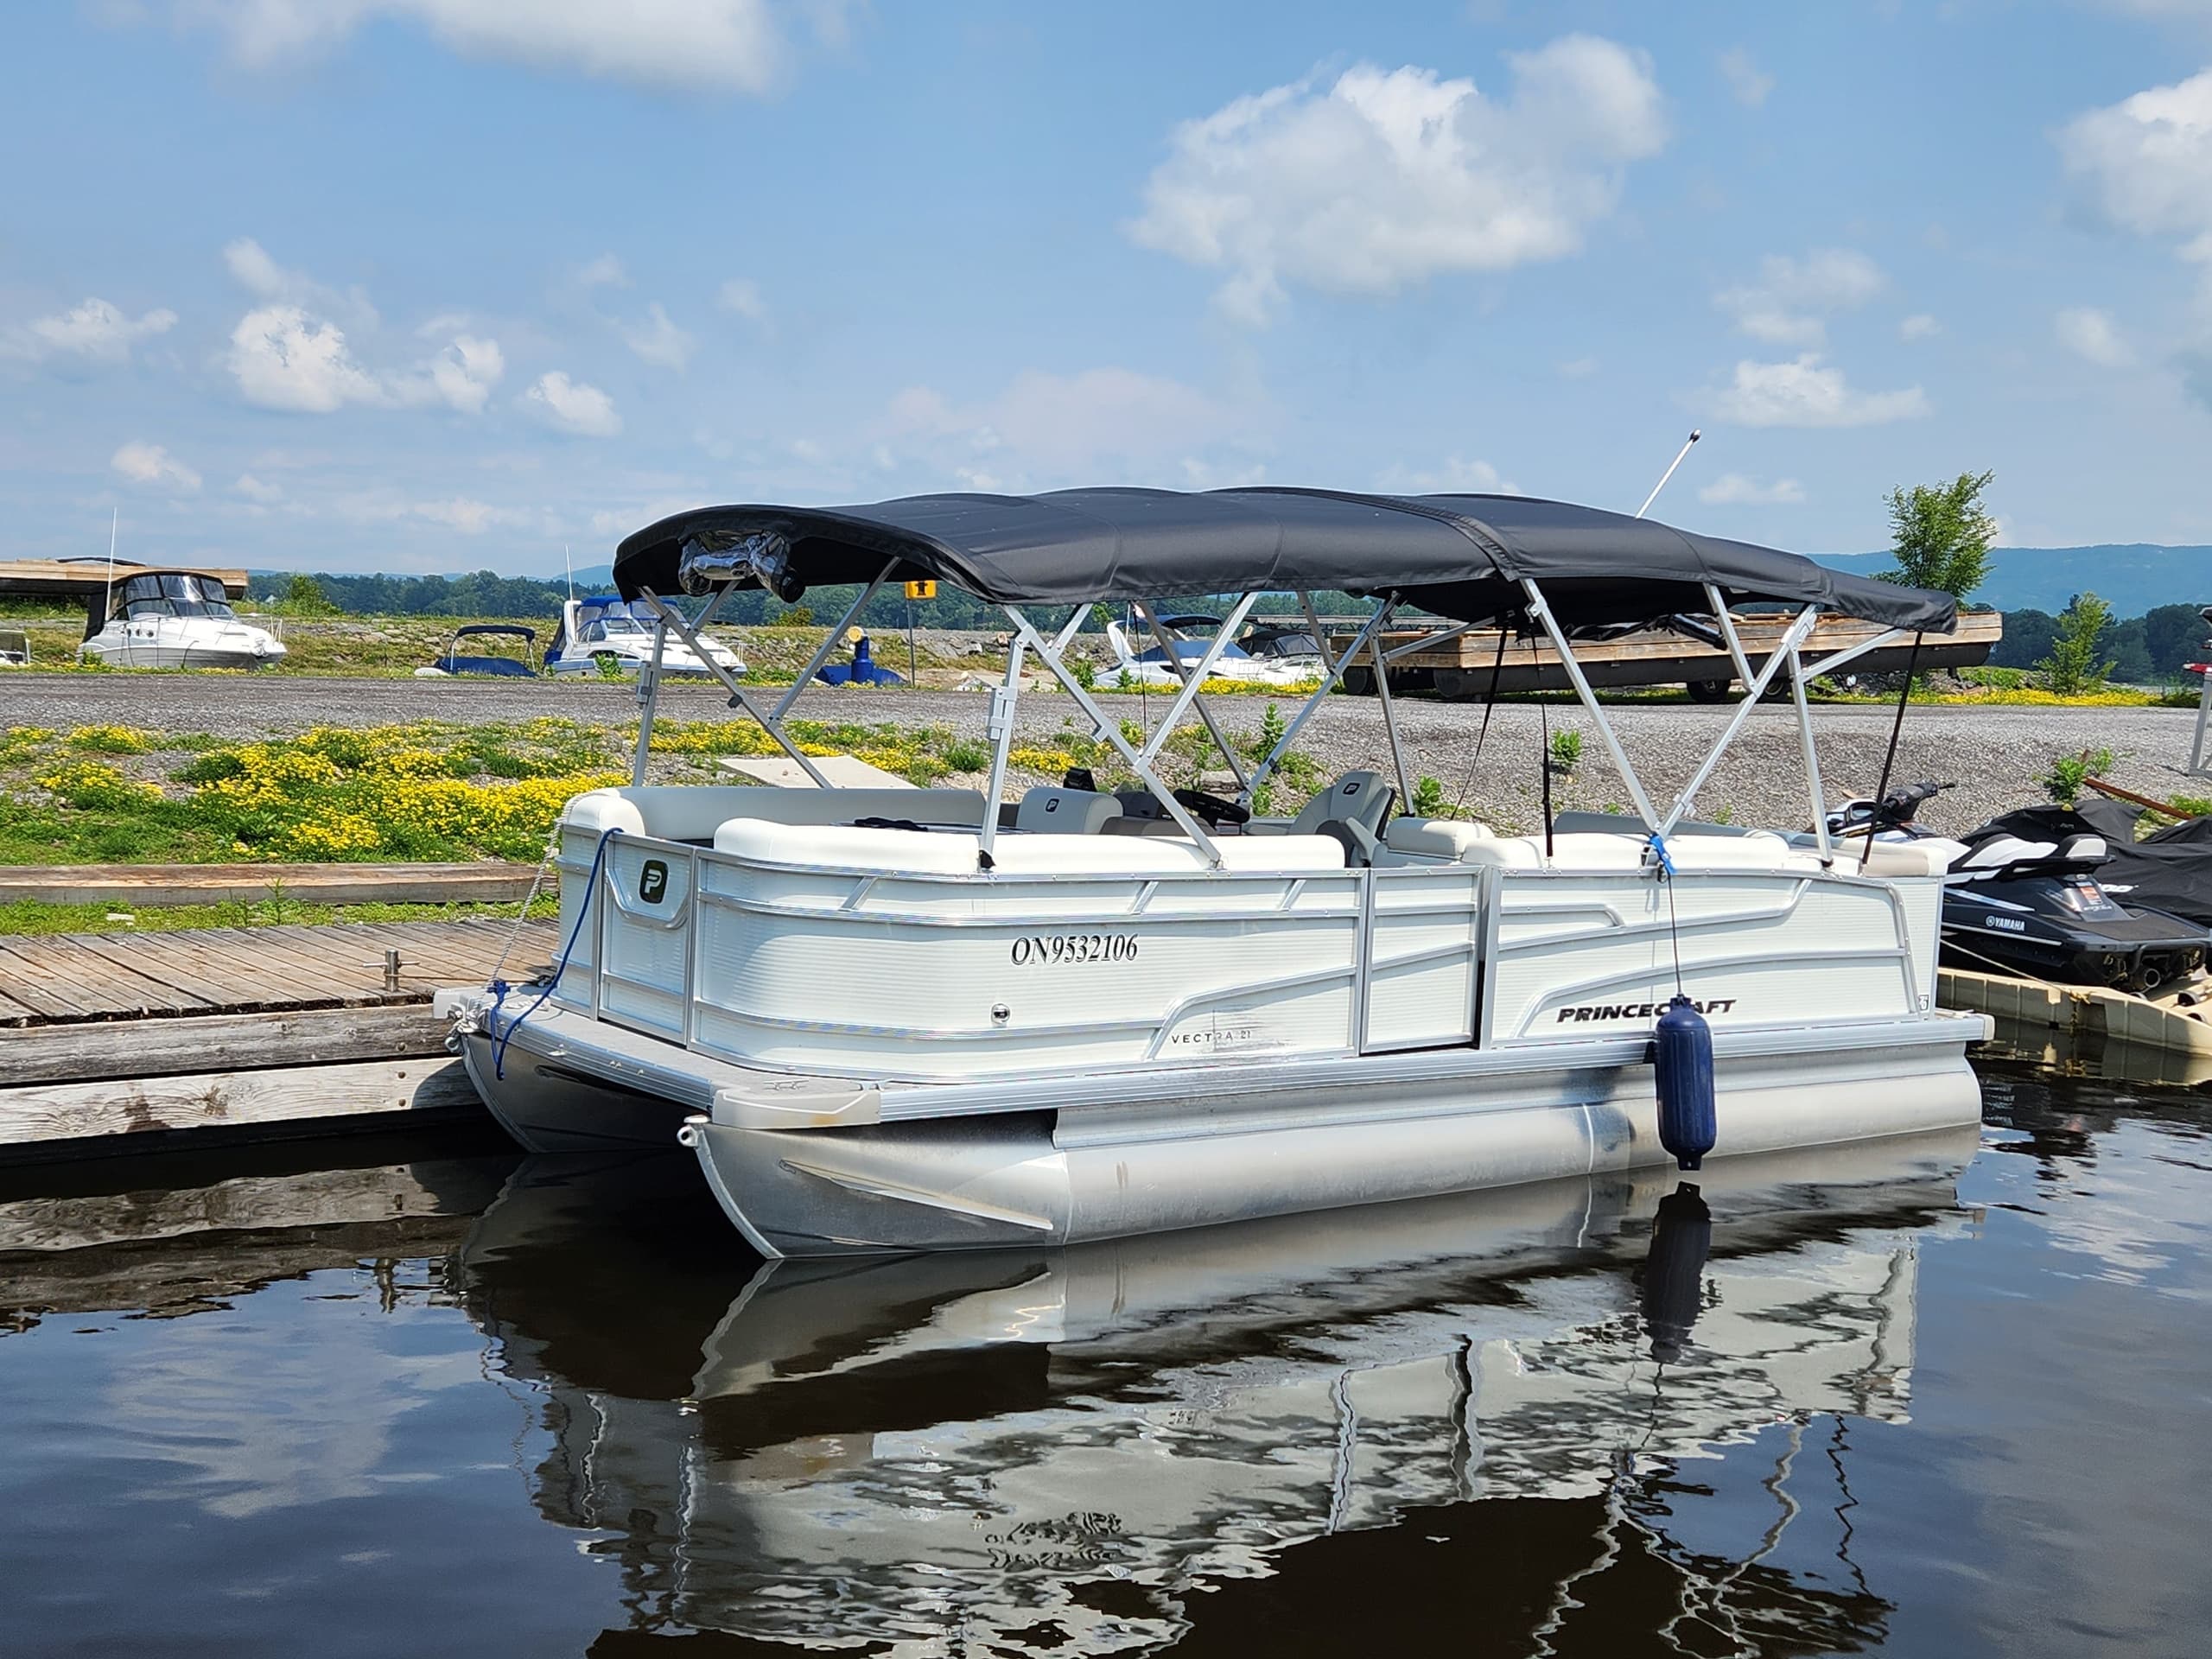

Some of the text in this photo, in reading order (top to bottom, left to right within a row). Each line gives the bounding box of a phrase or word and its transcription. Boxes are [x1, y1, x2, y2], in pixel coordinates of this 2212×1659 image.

[1995, 917, 2024, 931] YAMAHA
[1011, 933, 1139, 966] ON9532106
[1556, 999, 1737, 1023] PRINCECAFT
